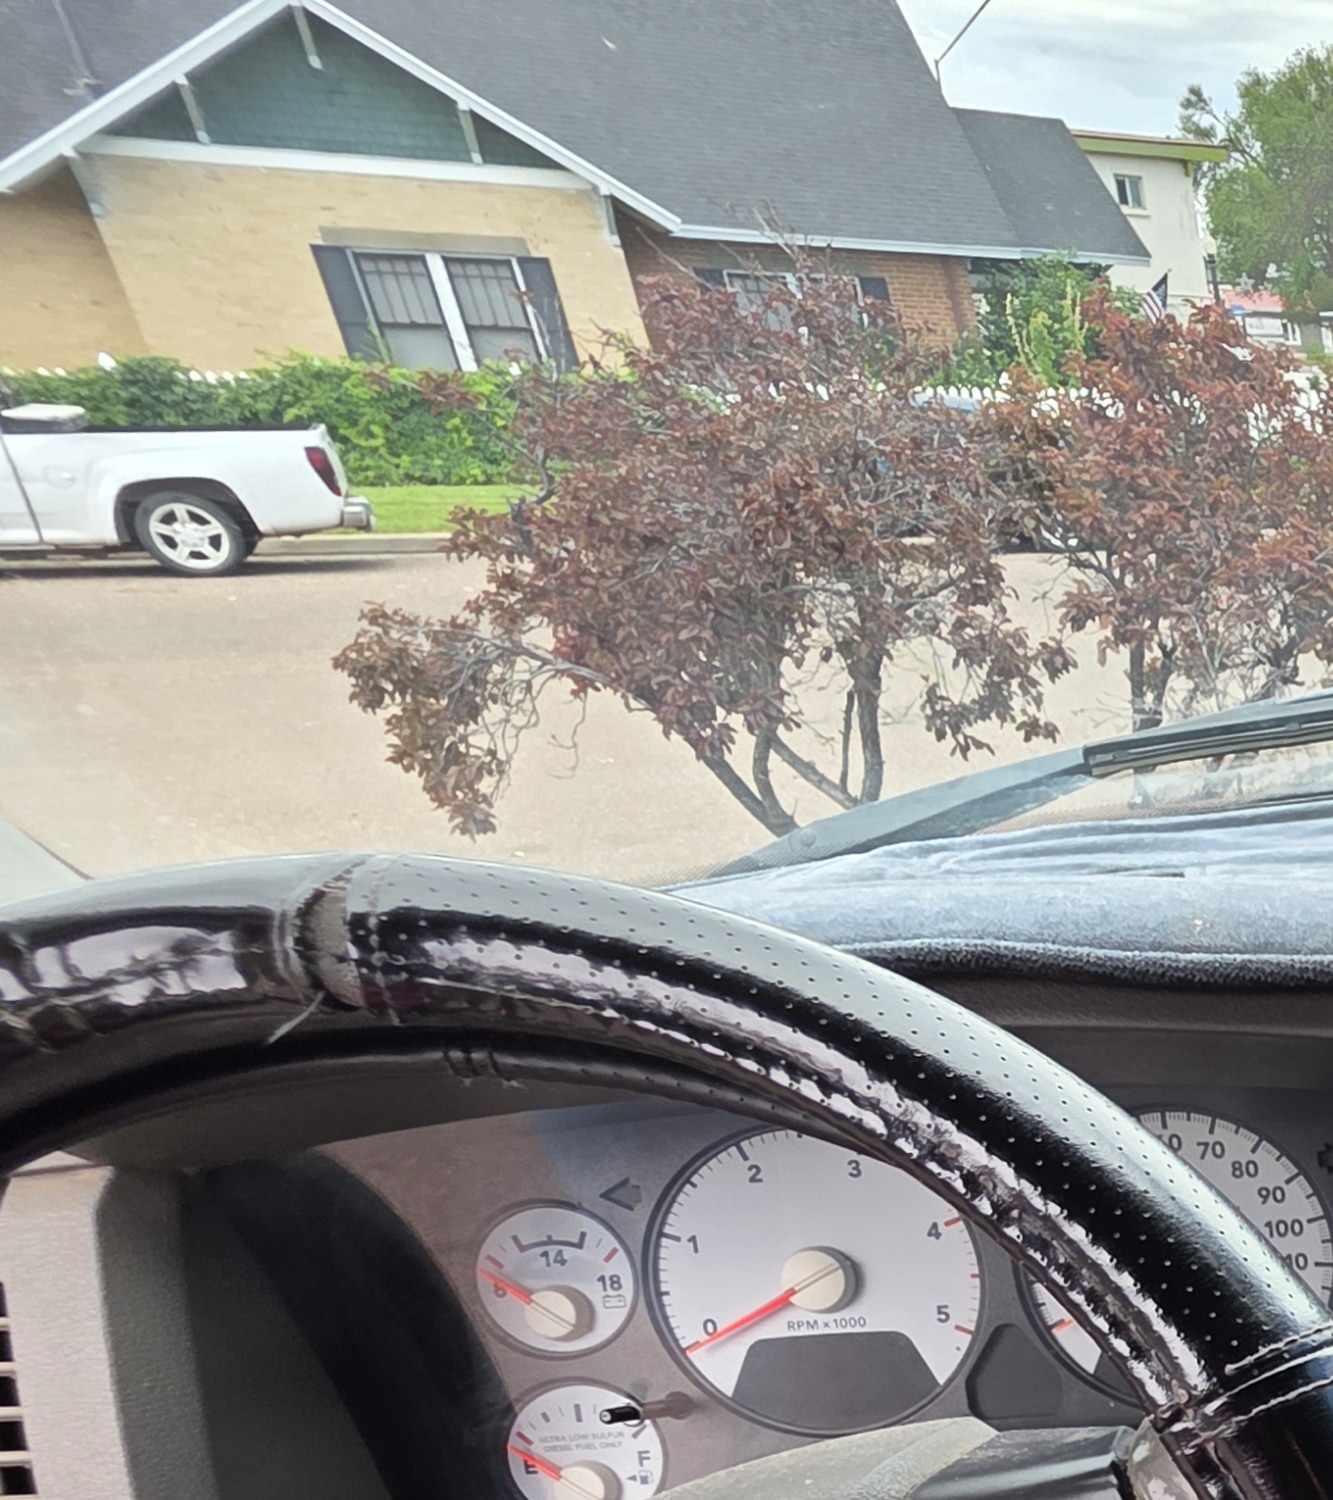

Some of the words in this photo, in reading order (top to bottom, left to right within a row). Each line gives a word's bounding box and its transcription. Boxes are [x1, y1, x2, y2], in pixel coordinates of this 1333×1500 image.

[1196, 1141, 1225, 1160] 70
[747, 1164, 763, 1183] 2
[847, 1159, 862, 1178] 3
[1231, 1160, 1259, 1179] 80
[1257, 1185, 1286, 1205] 90
[927, 1221, 942, 1240] 4
[1264, 1218, 1304, 1238] 100
[687, 1235, 699, 1254] 1
[540, 1249, 568, 1267] 14
[597, 1274, 623, 1292] 18
[936, 1304, 951, 1323] 5
[703, 1318, 718, 1337] 0
[787, 1319, 819, 1331] RPM
[538, 1434, 566, 1444] ULTRA
[568, 1432, 589, 1442] LOW
[637, 1450, 651, 1467] F
